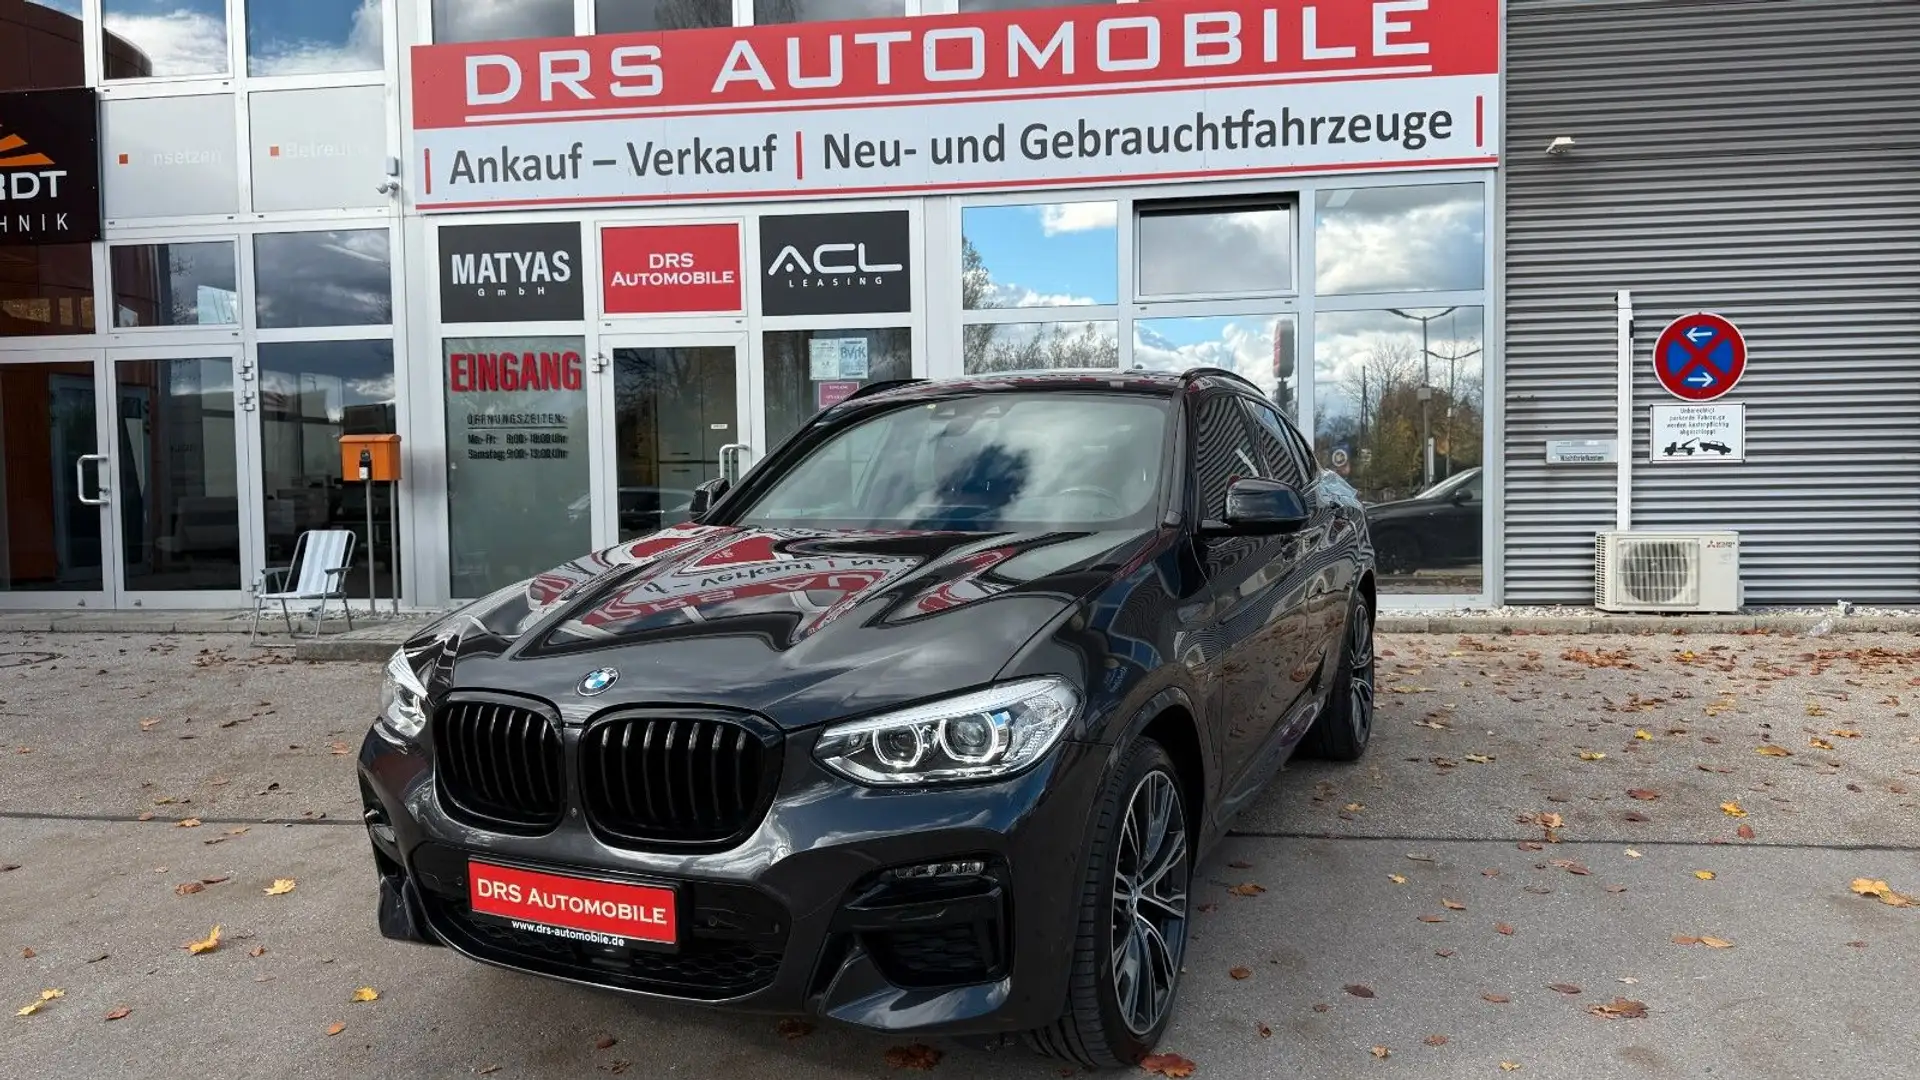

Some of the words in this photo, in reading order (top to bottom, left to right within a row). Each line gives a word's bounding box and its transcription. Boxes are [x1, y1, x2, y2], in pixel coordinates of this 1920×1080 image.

[464, 45, 663, 106] DRS
[711, 0, 1430, 93] AUTOMOBILE
[448, 141, 583, 185] Ankauf
[626, 133, 777, 178] Verkauf
[823, 132, 917, 170] Neu-
[930, 123, 1005, 166] und
[1019, 106, 1453, 162] Gebrauchtfahrzeuge
[0, 170, 67, 200] DT
[451, 250, 571, 285] MATYAS
[649, 252, 694, 269] DRS
[768, 242, 903, 276] ACL
[610, 270, 735, 287] AUTOMOBILE
[788, 276, 883, 288] LEASING
[450, 351, 583, 392] EINGANG
[476, 877, 522, 904] DRS
[527, 887, 667, 925] AUTOMOBILE
[511, 919, 625, 948] www.drs-automobile.de
